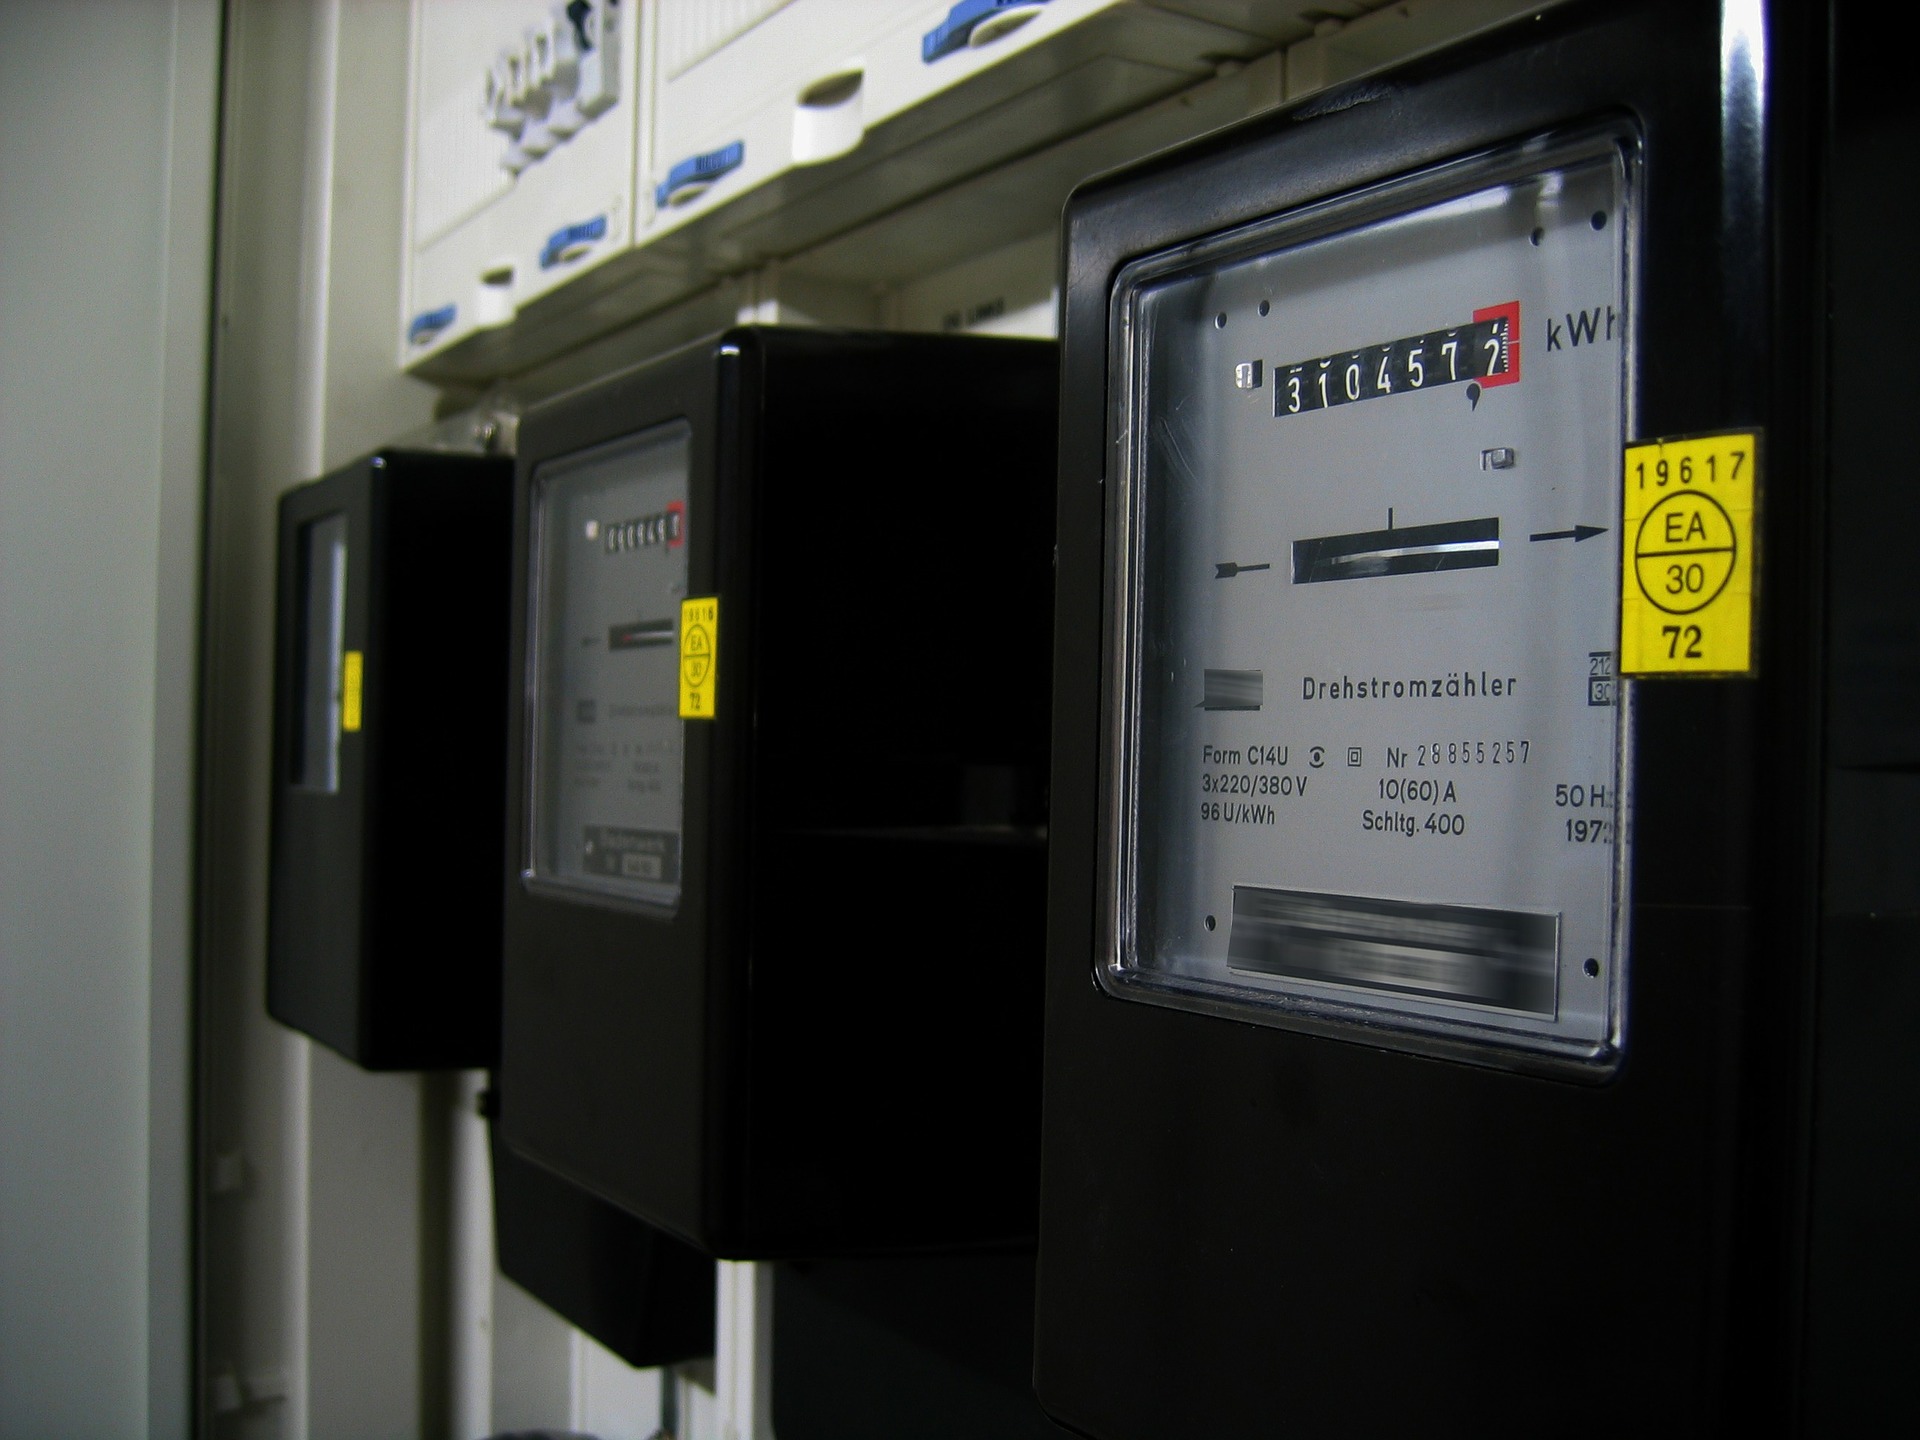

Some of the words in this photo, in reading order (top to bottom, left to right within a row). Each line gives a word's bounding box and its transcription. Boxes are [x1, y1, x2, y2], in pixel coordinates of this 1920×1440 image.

[1286, 336, 1501, 413] 3104572
[1635, 450, 1746, 490] 19617
[1664, 510, 1707, 544] EA
[1665, 563, 1705, 595] 30
[1661, 624, 1703, 659] 72
[1302, 671, 1517, 701] Drehstromzähler
[1202, 744, 1241, 764] Form
[1247, 745, 1289, 766] C14U
[1386, 746, 1408, 768] Nr
[1417, 740, 1531, 767] 28855257
[1202, 773, 1293, 797] 3x220/380
[1296, 775, 1308, 797] V
[1378, 777, 1440, 806] 10(60)
[1442, 780, 1457, 803] A
[1555, 783, 1585, 808] 50
[1590, 784, 1613, 809] H
[1200, 801, 1221, 821] 96
[1223, 802, 1276, 825] U/kWh
[1362, 809, 1420, 837] Schltg.
[1424, 812, 1465, 836] 400
